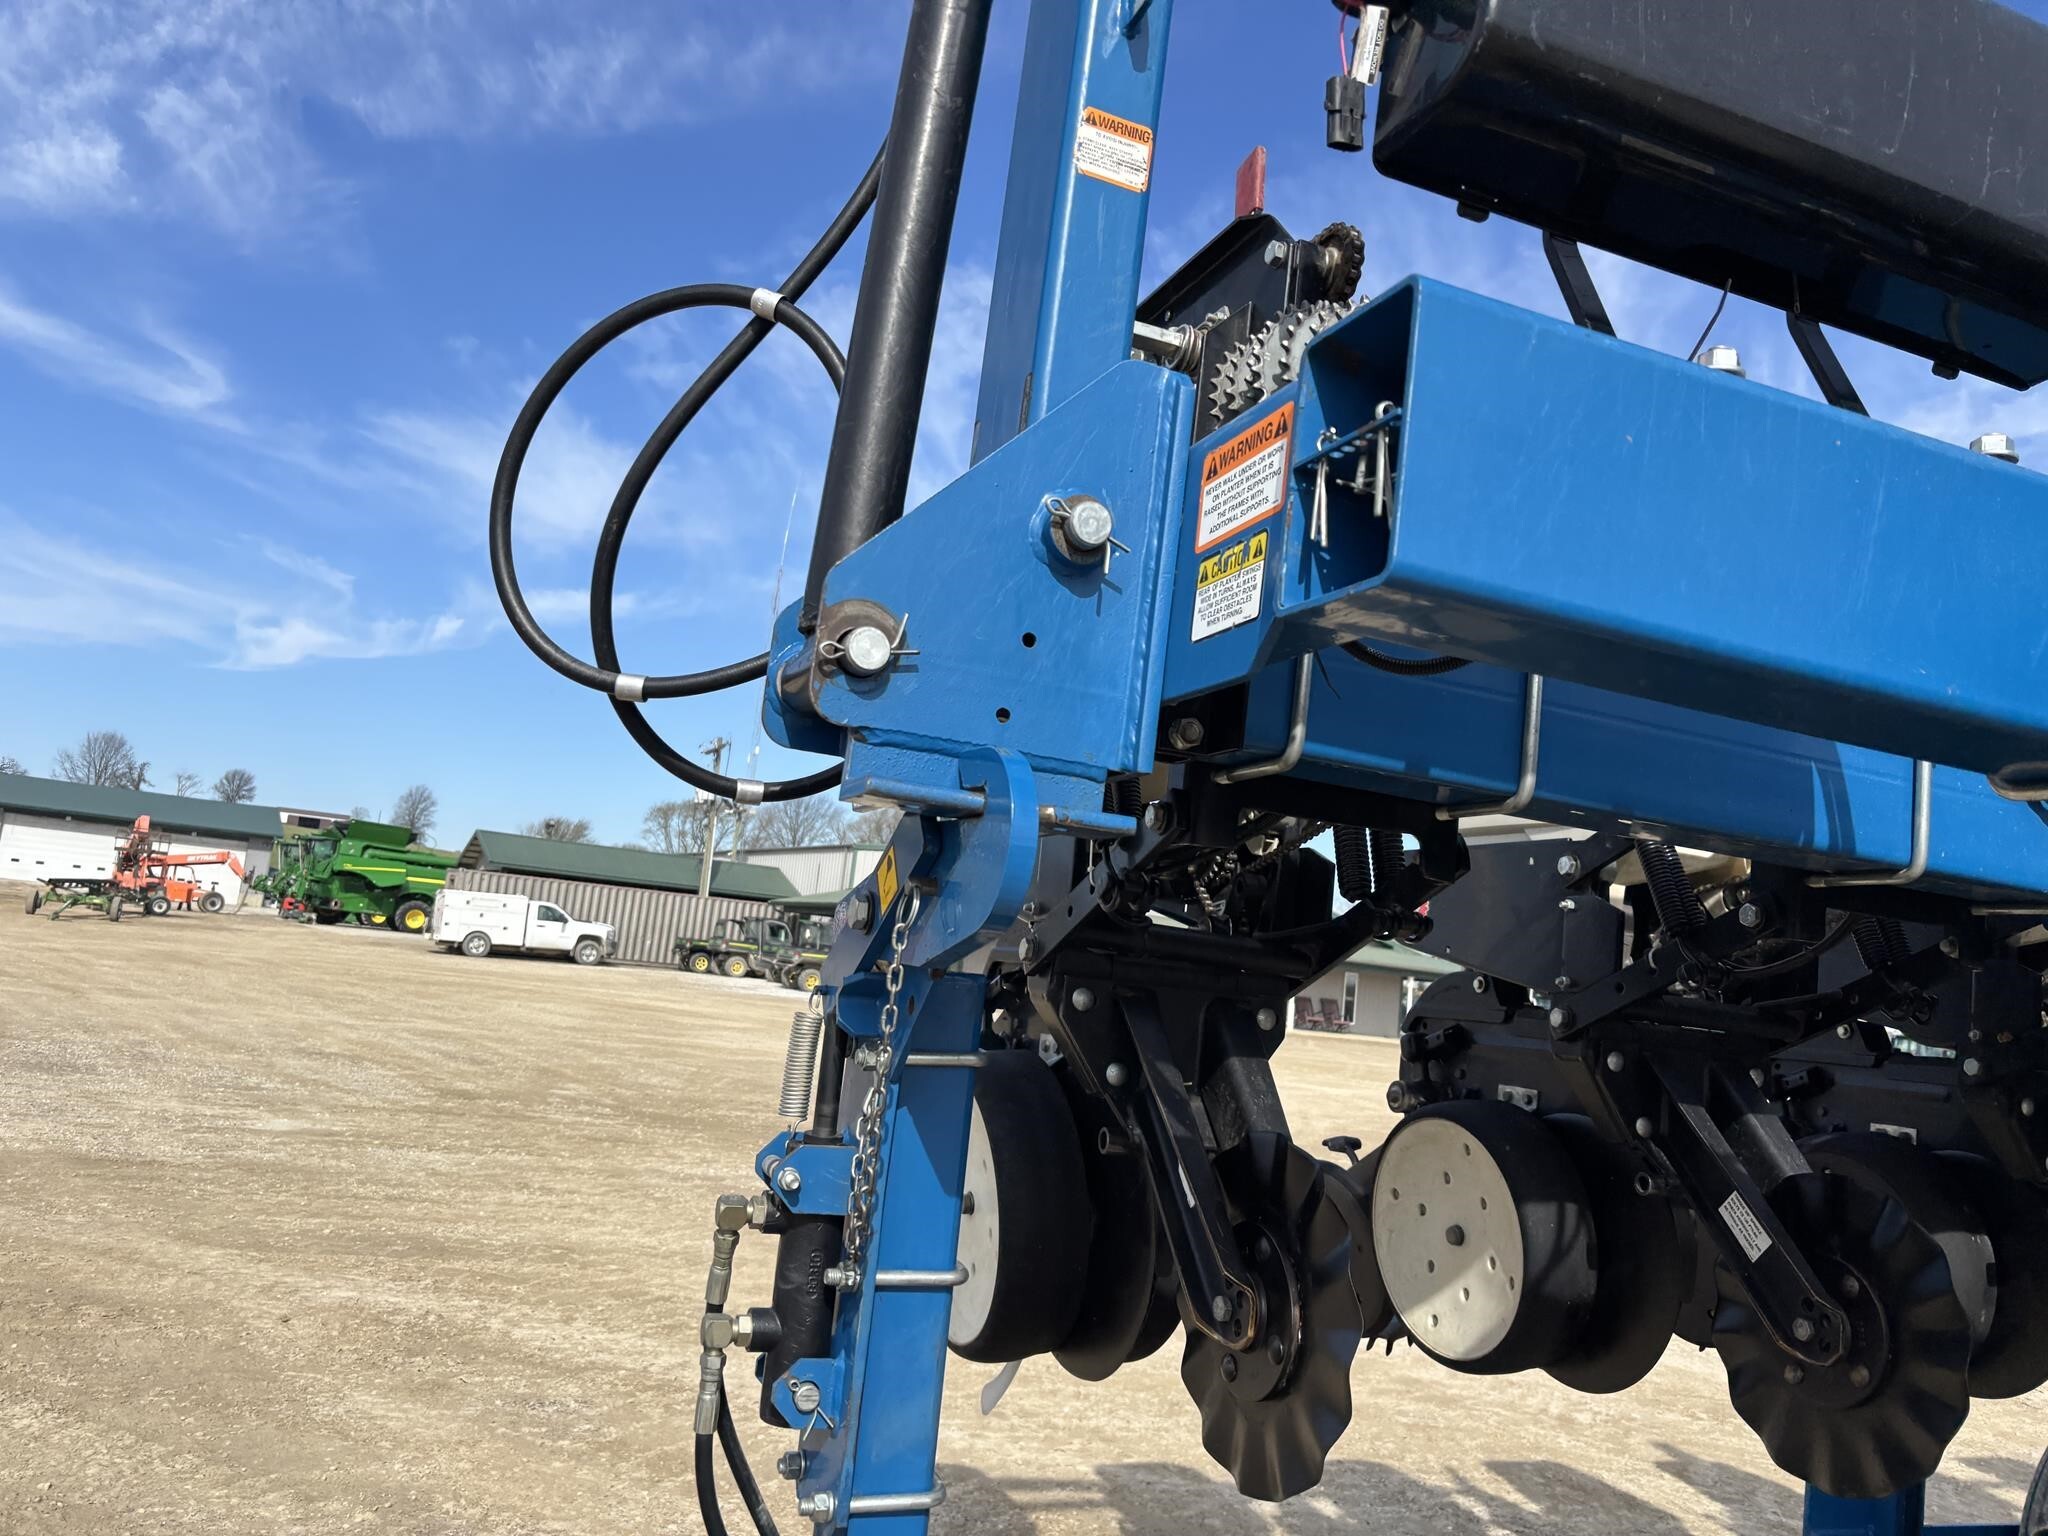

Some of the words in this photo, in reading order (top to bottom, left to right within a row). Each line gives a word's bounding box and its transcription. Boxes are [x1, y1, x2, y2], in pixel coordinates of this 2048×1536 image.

[1098, 114, 1151, 143] WARNING
[1219, 422, 1273, 470] WARNING
[1205, 481, 1222, 496] NEVER
[1222, 472, 1238, 486] WALK
[1238, 461, 1257, 477] UNDER
[1257, 454, 1266, 465] OR
[1267, 444, 1284, 460] WORK
[1211, 493, 1220, 503] ON
[1220, 478, 1244, 498] PLANTER
[1245, 469, 1261, 484] WHEN
[1261, 464, 1267, 474] IT
[1268, 460, 1274, 471] IS
[1204, 502, 1222, 517] RAISED
[1222, 488, 1246, 507] WITHOUT
[1246, 467, 1282, 493] SUPPORTING
[1217, 510, 1226, 520] THE
[1227, 497, 1250, 515] FRAMES
[1250, 488, 1265, 503] WITH
[1209, 512, 1239, 534] ADDITIONAL
[1211, 546, 1250, 578] CAUTION
[1198, 587, 1211, 598] REAR
[1211, 583, 1219, 592] OF
[1219, 572, 1241, 588] PLANTER
[1242, 563, 1262, 578] SWINGS
[1200, 593, 1212, 604] WIDE
[1212, 590, 1218, 599] IN
[1235, 574, 1257, 589] ALWAYS
[1198, 602, 1214, 614] ALLOW
[1214, 590, 1242, 607] SUFFICIENT
[1242, 583, 1258, 596] ROOM
[1200, 613, 1207, 622] TO
[1207, 606, 1223, 618] CLEAR
[1223, 593, 1253, 612] OBSTACLES
[1207, 615, 1220, 627] WHEN
